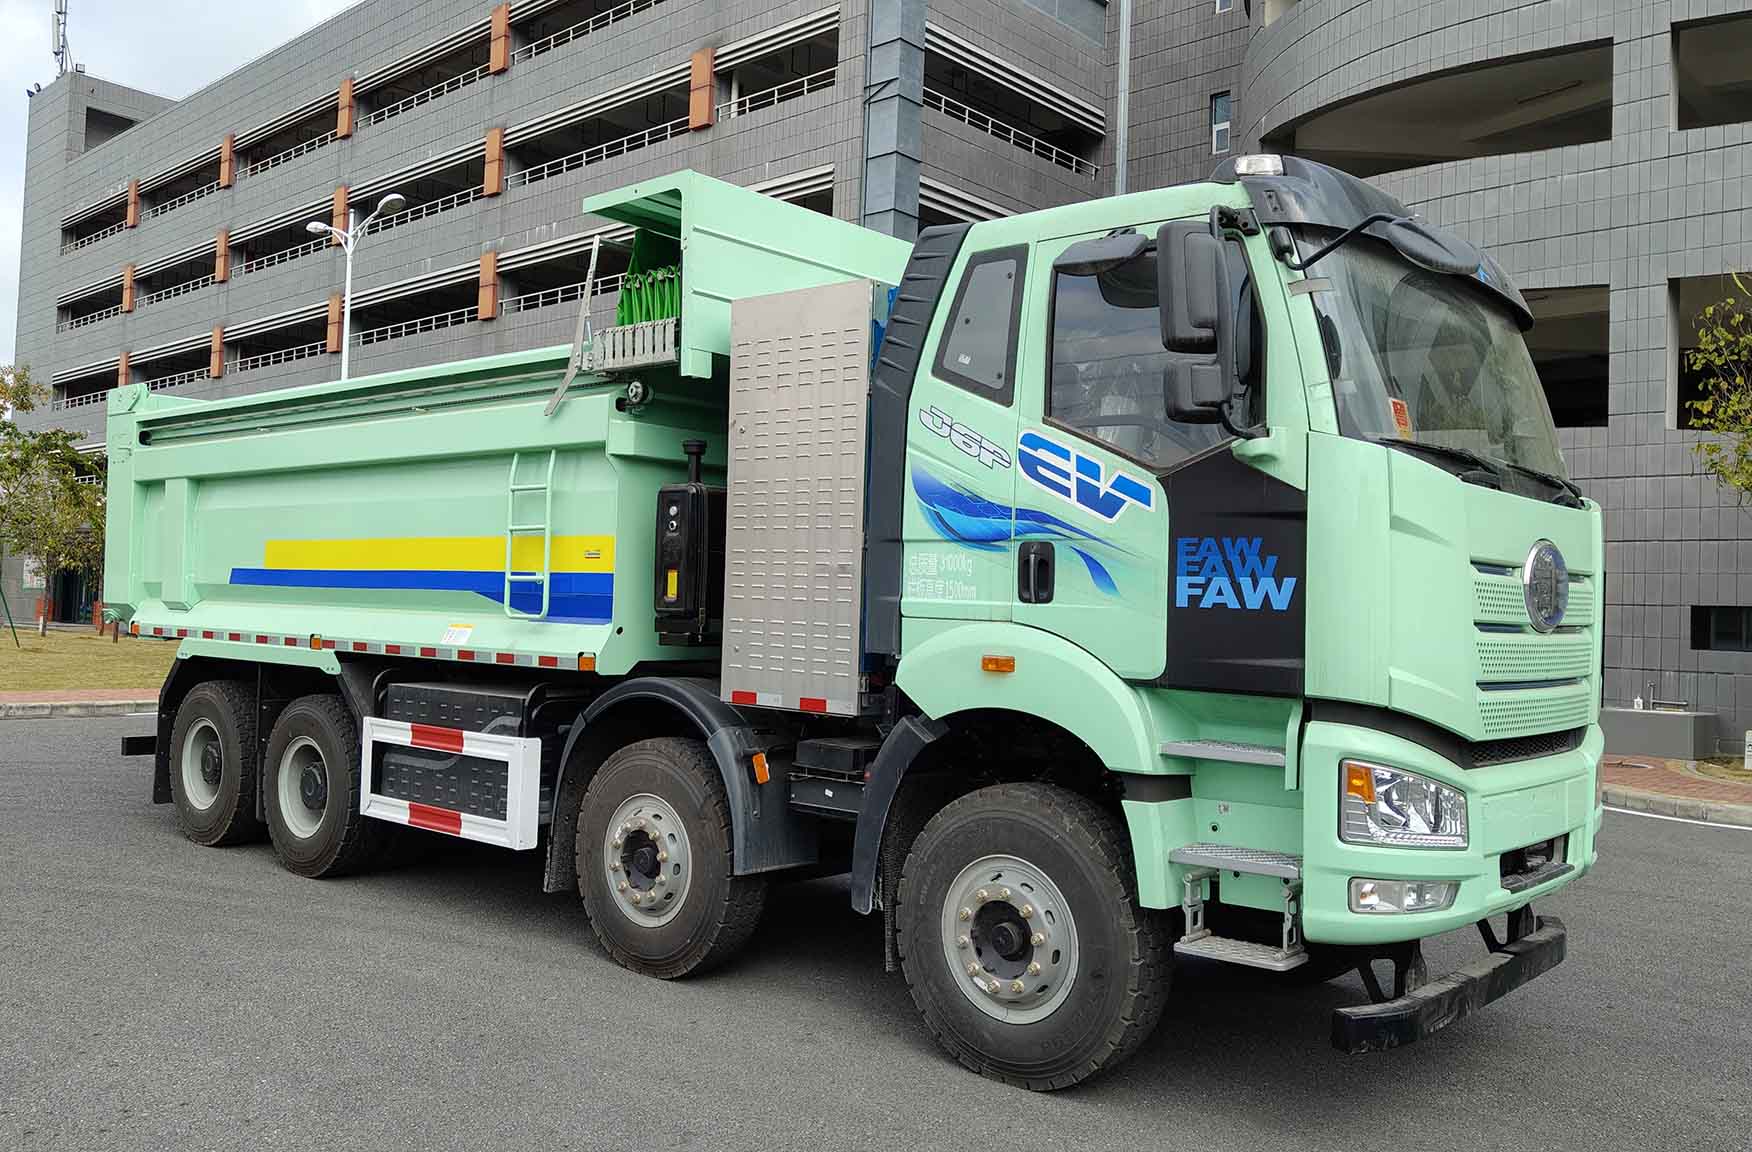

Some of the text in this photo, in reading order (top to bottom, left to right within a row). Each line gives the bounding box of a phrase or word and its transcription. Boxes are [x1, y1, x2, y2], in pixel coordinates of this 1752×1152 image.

[918, 404, 1012, 470] J6P
[1017, 428, 1154, 522] EV
[1175, 575, 1297, 610] FAW
